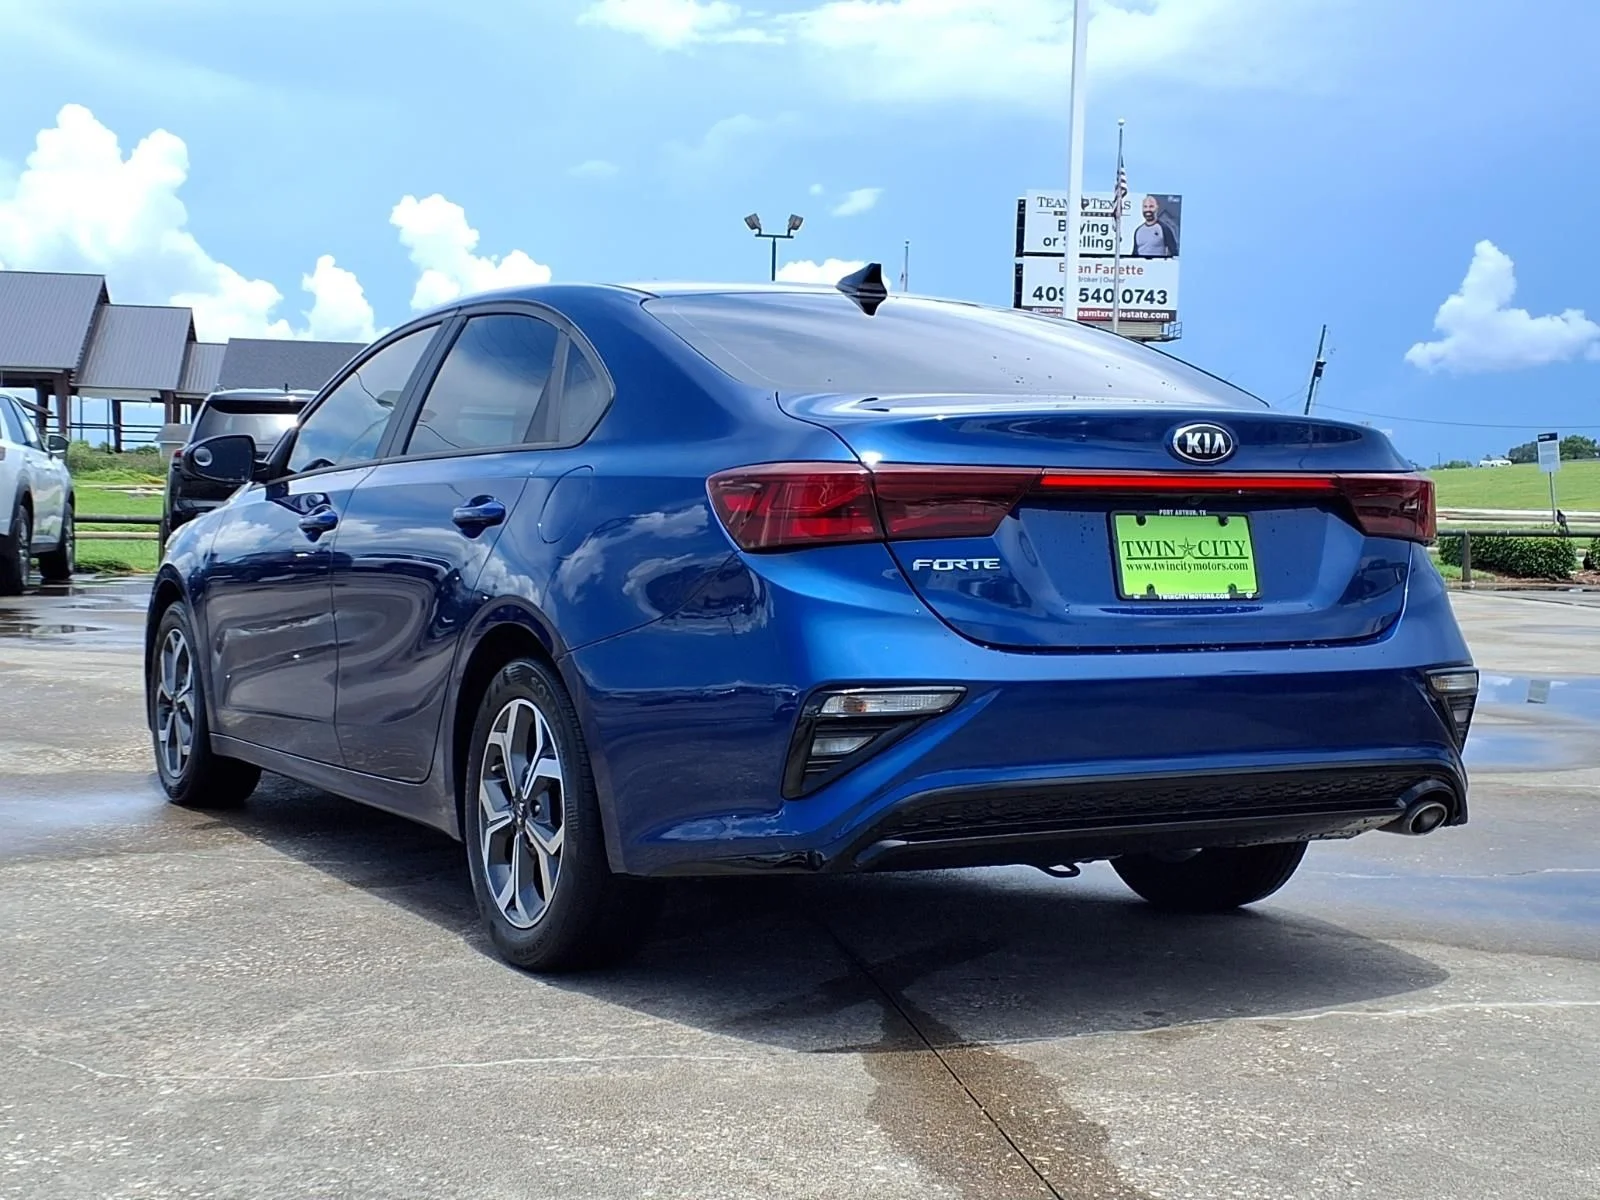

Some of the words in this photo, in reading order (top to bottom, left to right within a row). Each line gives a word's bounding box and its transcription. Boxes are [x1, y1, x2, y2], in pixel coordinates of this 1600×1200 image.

[1058, 219, 1109, 236] Bying
[1043, 237, 1059, 247] or
[1063, 235, 1123, 251] lling
[1103, 276, 1126, 284] Ower
[1078, 308, 1170, 320] eamtxrelestate.com
[1186, 431, 1226, 454] KIA
[1121, 540, 1178, 557] TWIN
[1197, 539, 1247, 557] CITY
[912, 557, 1001, 572] FORTE
[1126, 560, 1249, 574] www.twincitymotors.com
